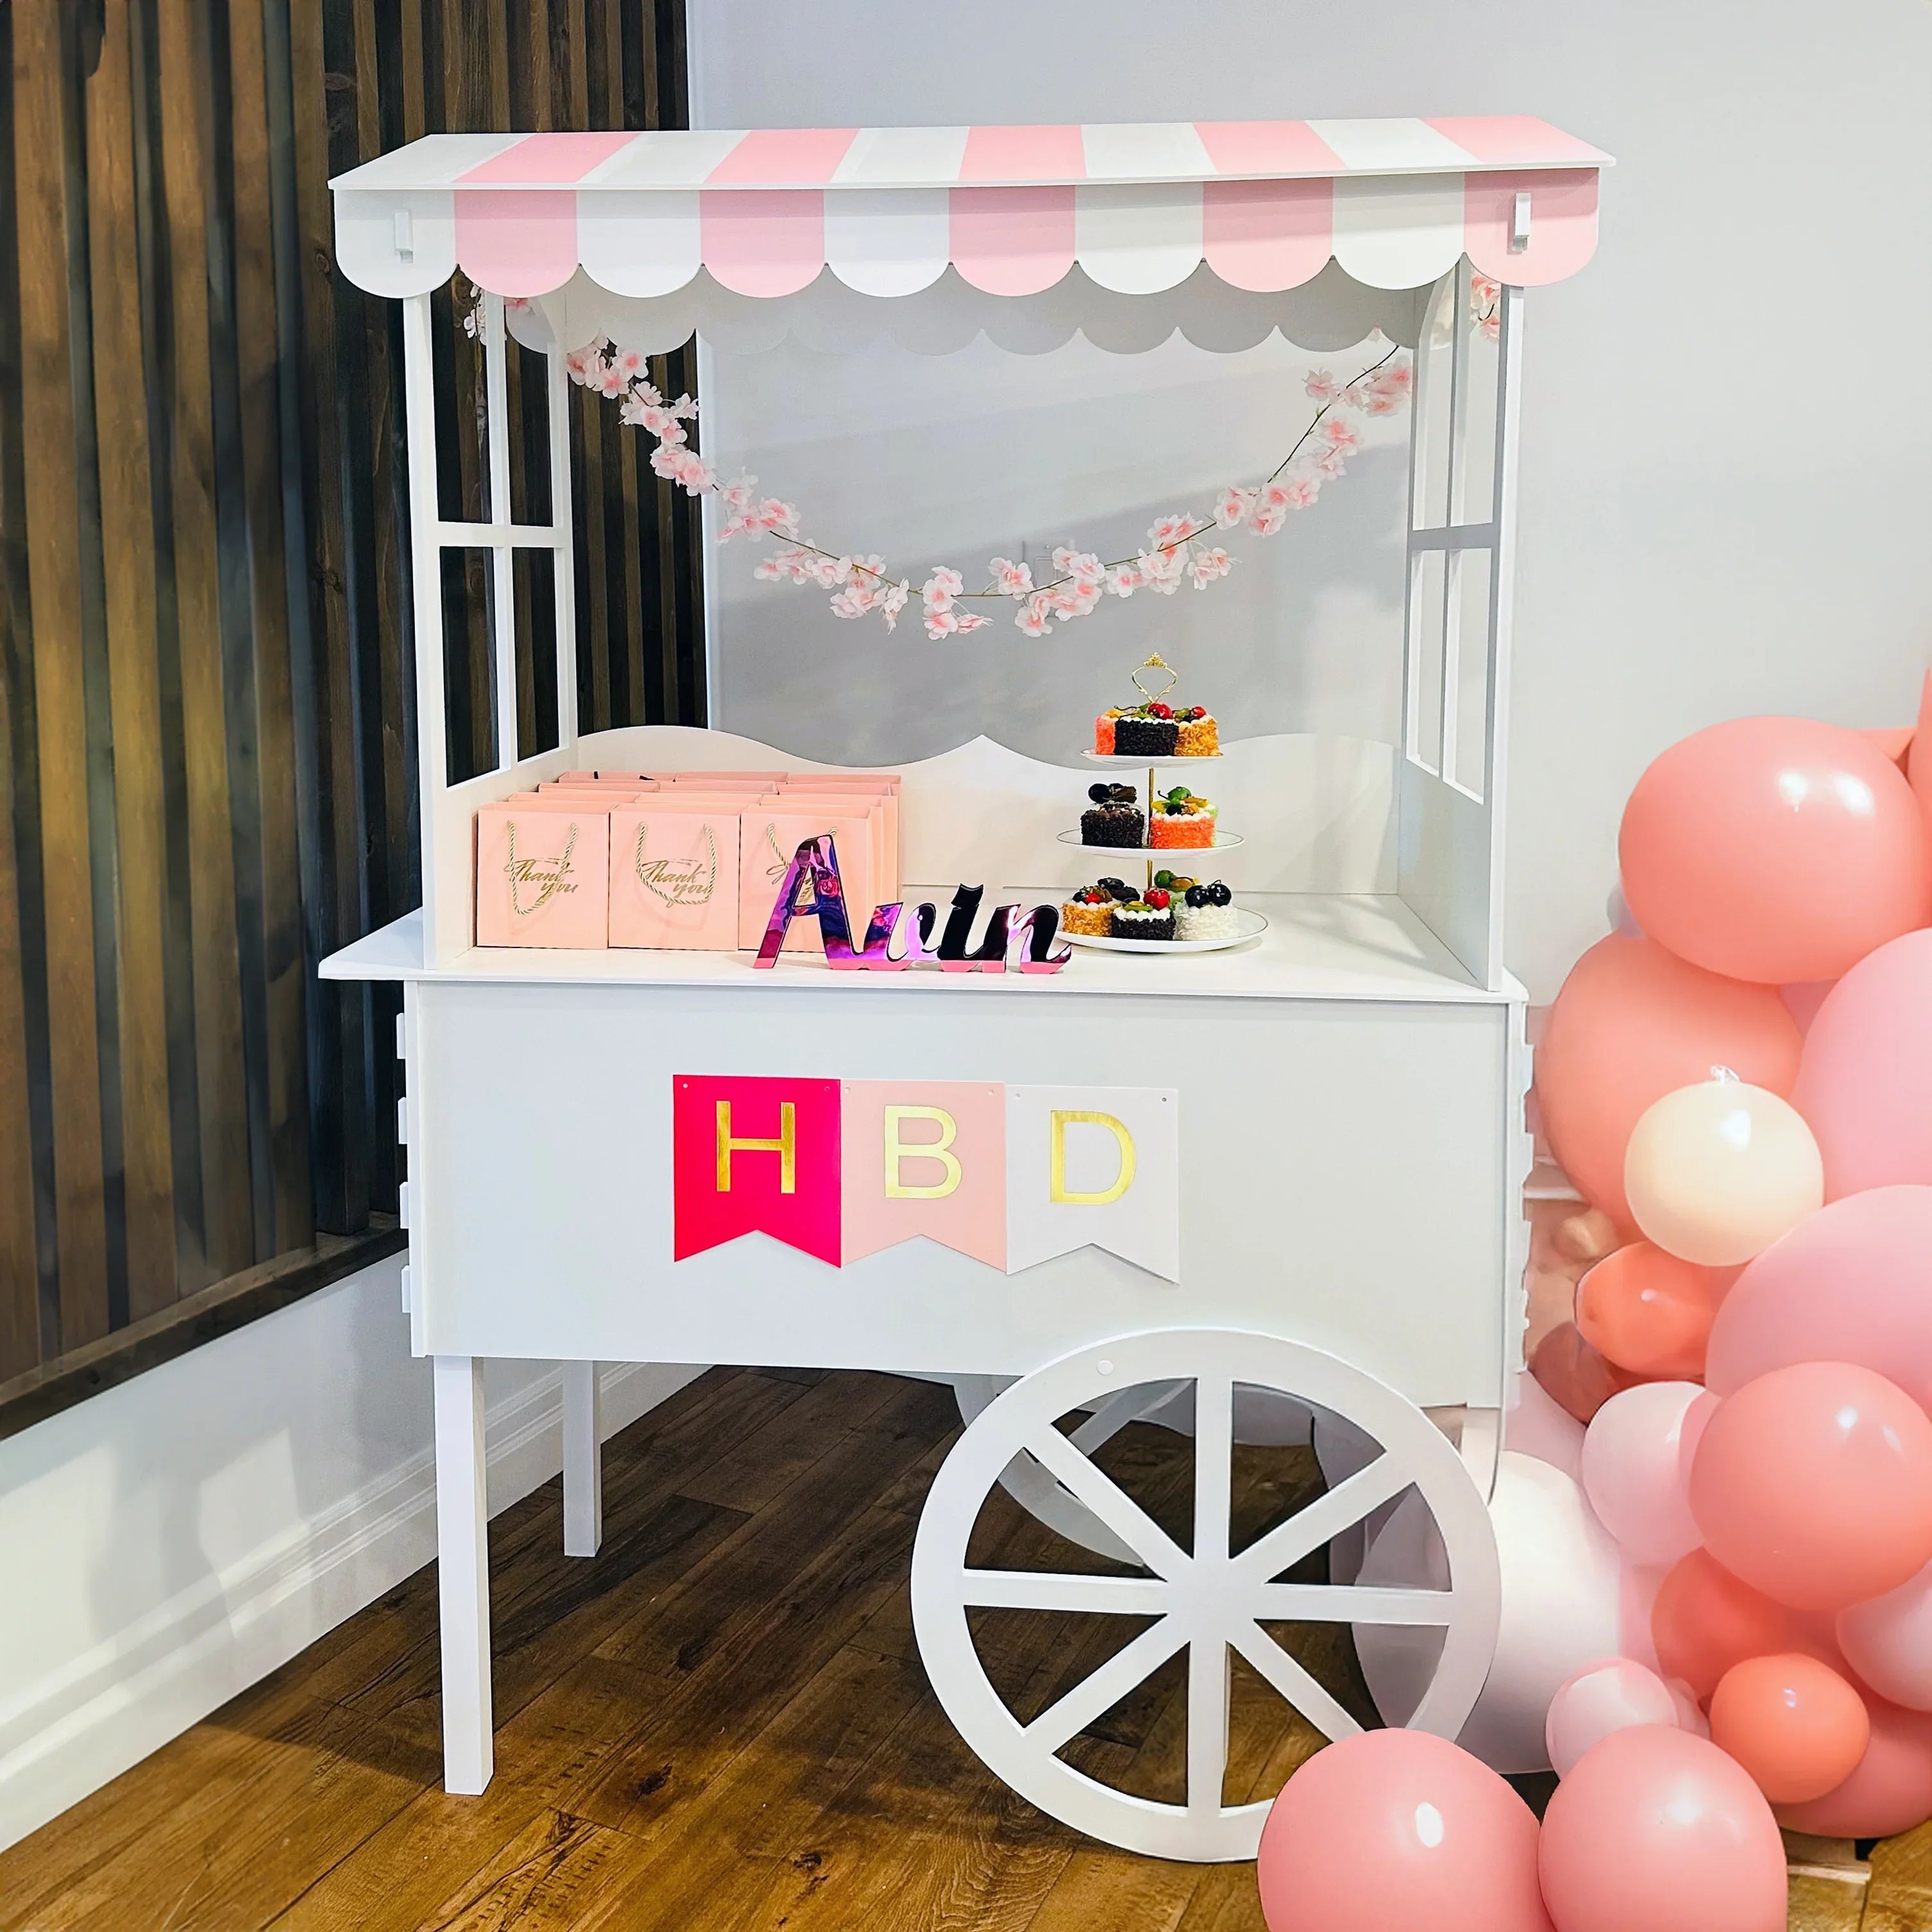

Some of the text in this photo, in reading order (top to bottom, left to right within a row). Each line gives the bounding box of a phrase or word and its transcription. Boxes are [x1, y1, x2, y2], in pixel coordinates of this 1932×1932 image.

[503, 857, 575, 882] Thank
[636, 858, 706, 883] Thank
[540, 882, 579, 903] you
[666, 883, 709, 908] you
